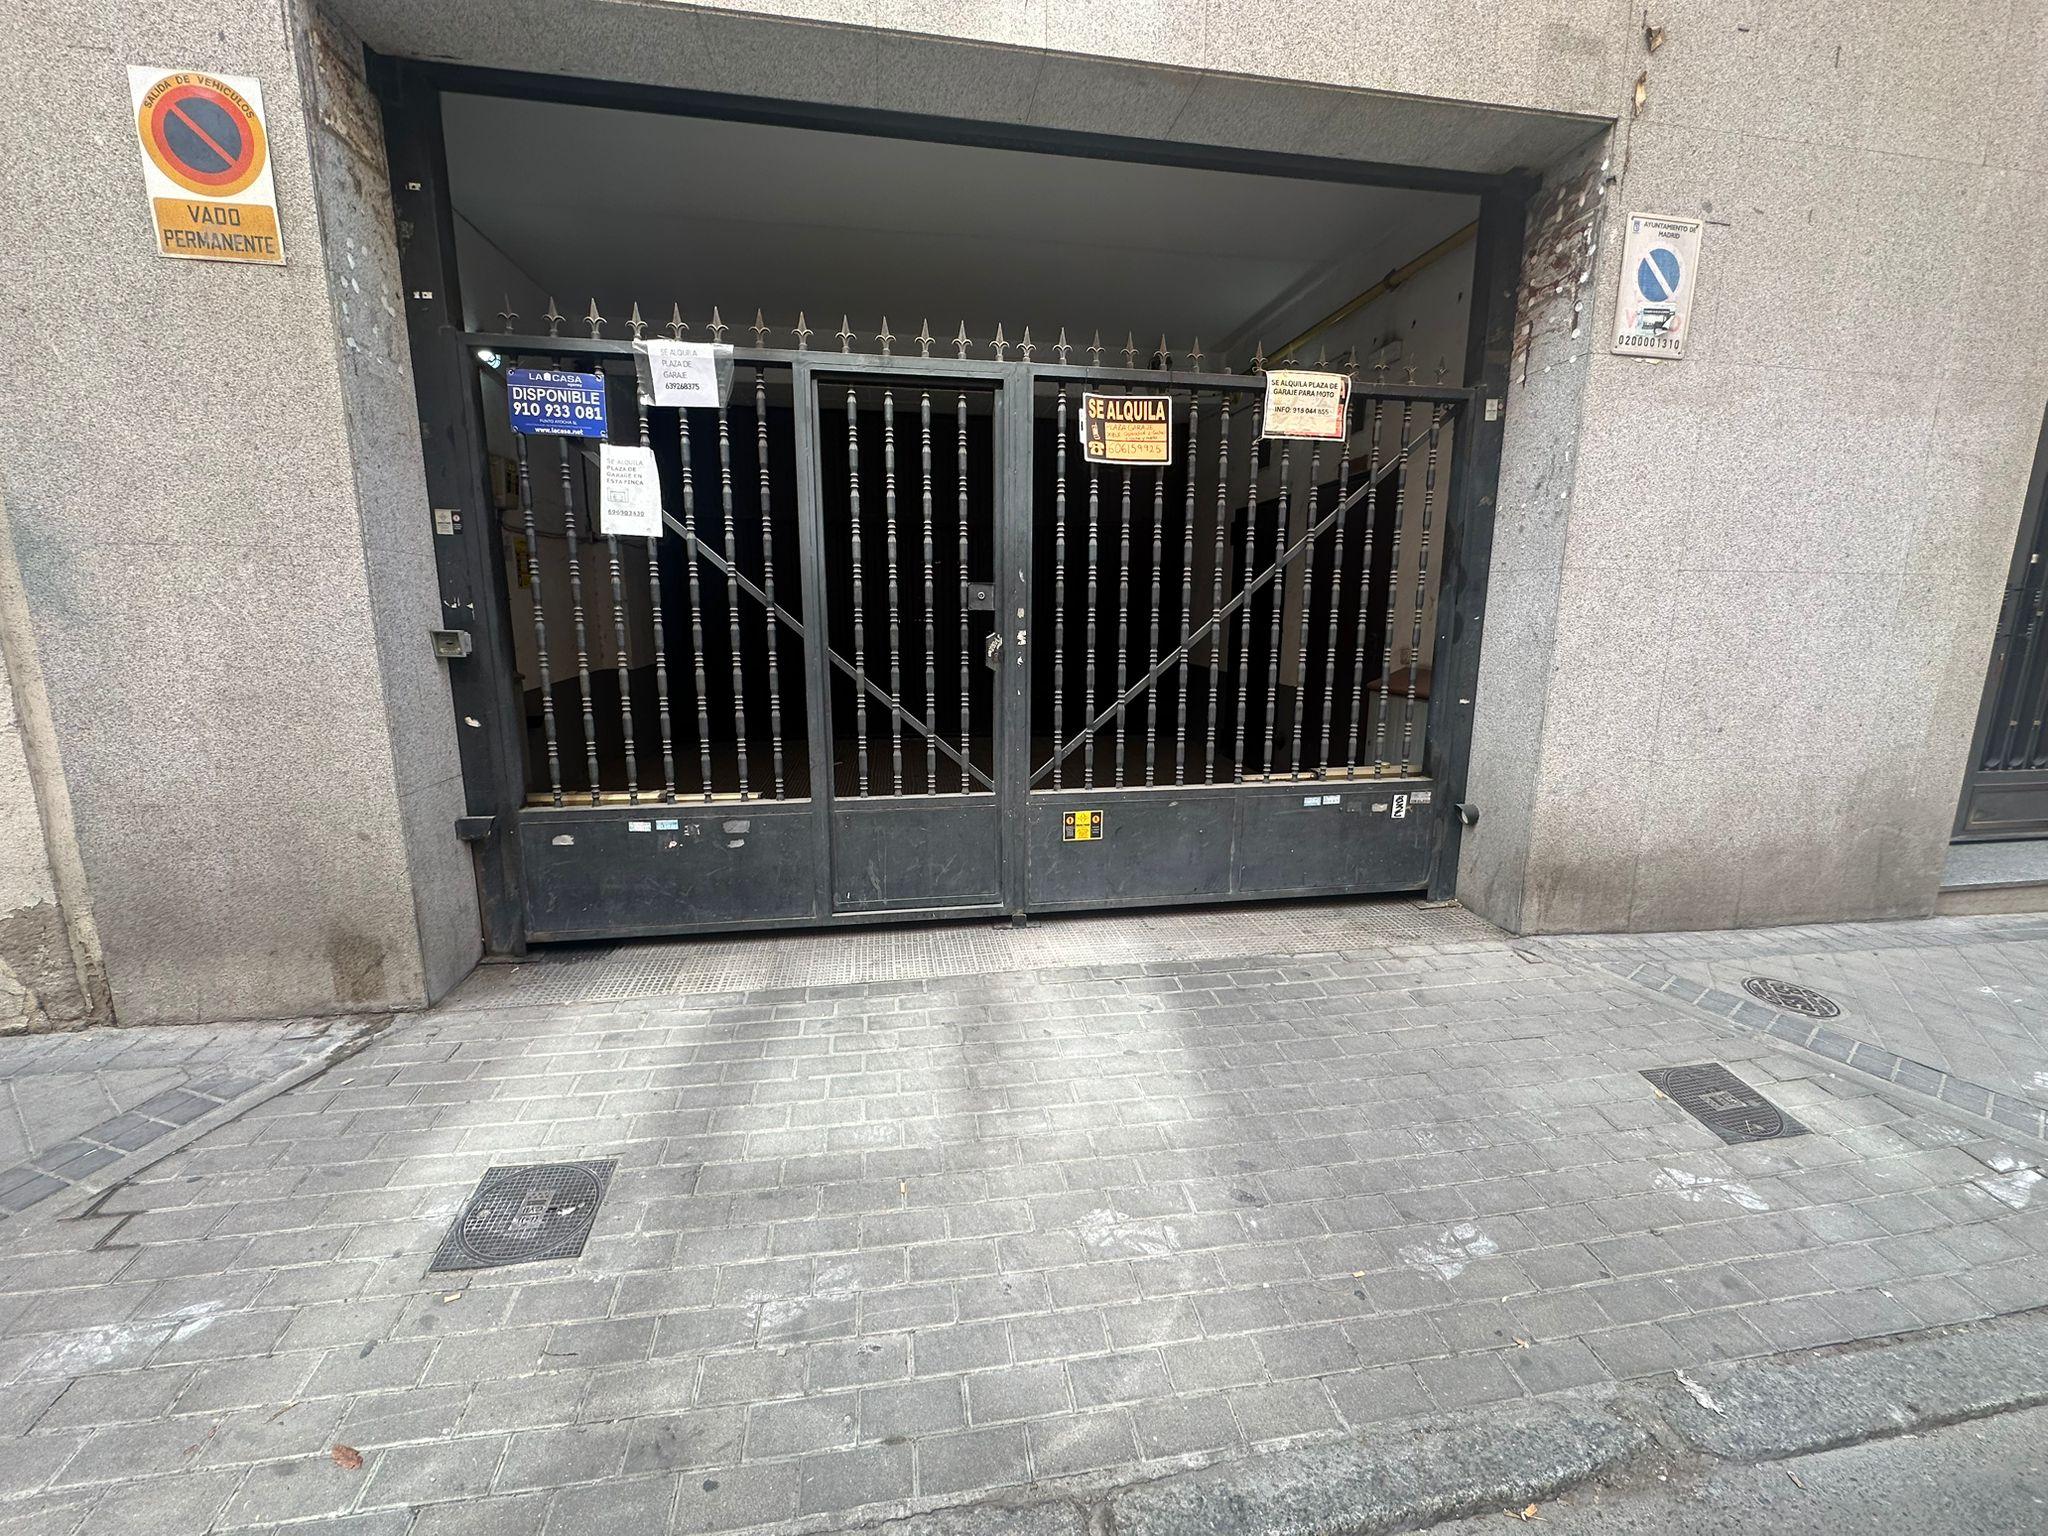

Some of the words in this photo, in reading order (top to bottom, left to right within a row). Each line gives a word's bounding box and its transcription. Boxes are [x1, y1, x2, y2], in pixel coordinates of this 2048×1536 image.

[143, 80, 172, 109] SALIDA
[175, 74, 191, 85] DE
[197, 75, 255, 120] VEHICULOS
[187, 204, 241, 226] VADO
[1643, 221, 1688, 233] AYUNTAMIENTO
[1658, 231, 1680, 240] MADRID
[163, 229, 276, 255] PERMANENTE
[1618, 334, 1680, 350] 0200001310
[660, 348, 668, 356] SE
[661, 359, 682, 368] PLAZA
[683, 360, 693, 368] DE
[528, 372, 543, 381] LA
[551, 374, 583, 384] CASA
[663, 370, 688, 379] GARAJE
[1280, 380, 1307, 388] ALQUILA
[1308, 381, 1328, 389] PLAZA
[512, 387, 600, 405] DISPONIBLE
[1273, 388, 1298, 396] GARAJE
[1316, 390, 1335, 398] MOTO
[513, 402, 540, 417] 910
[544, 403, 570, 418] 933
[575, 405, 603, 420] 081
[1088, 398, 1105, 419] SE
[1106, 400, 1166, 422] ALQUILA
